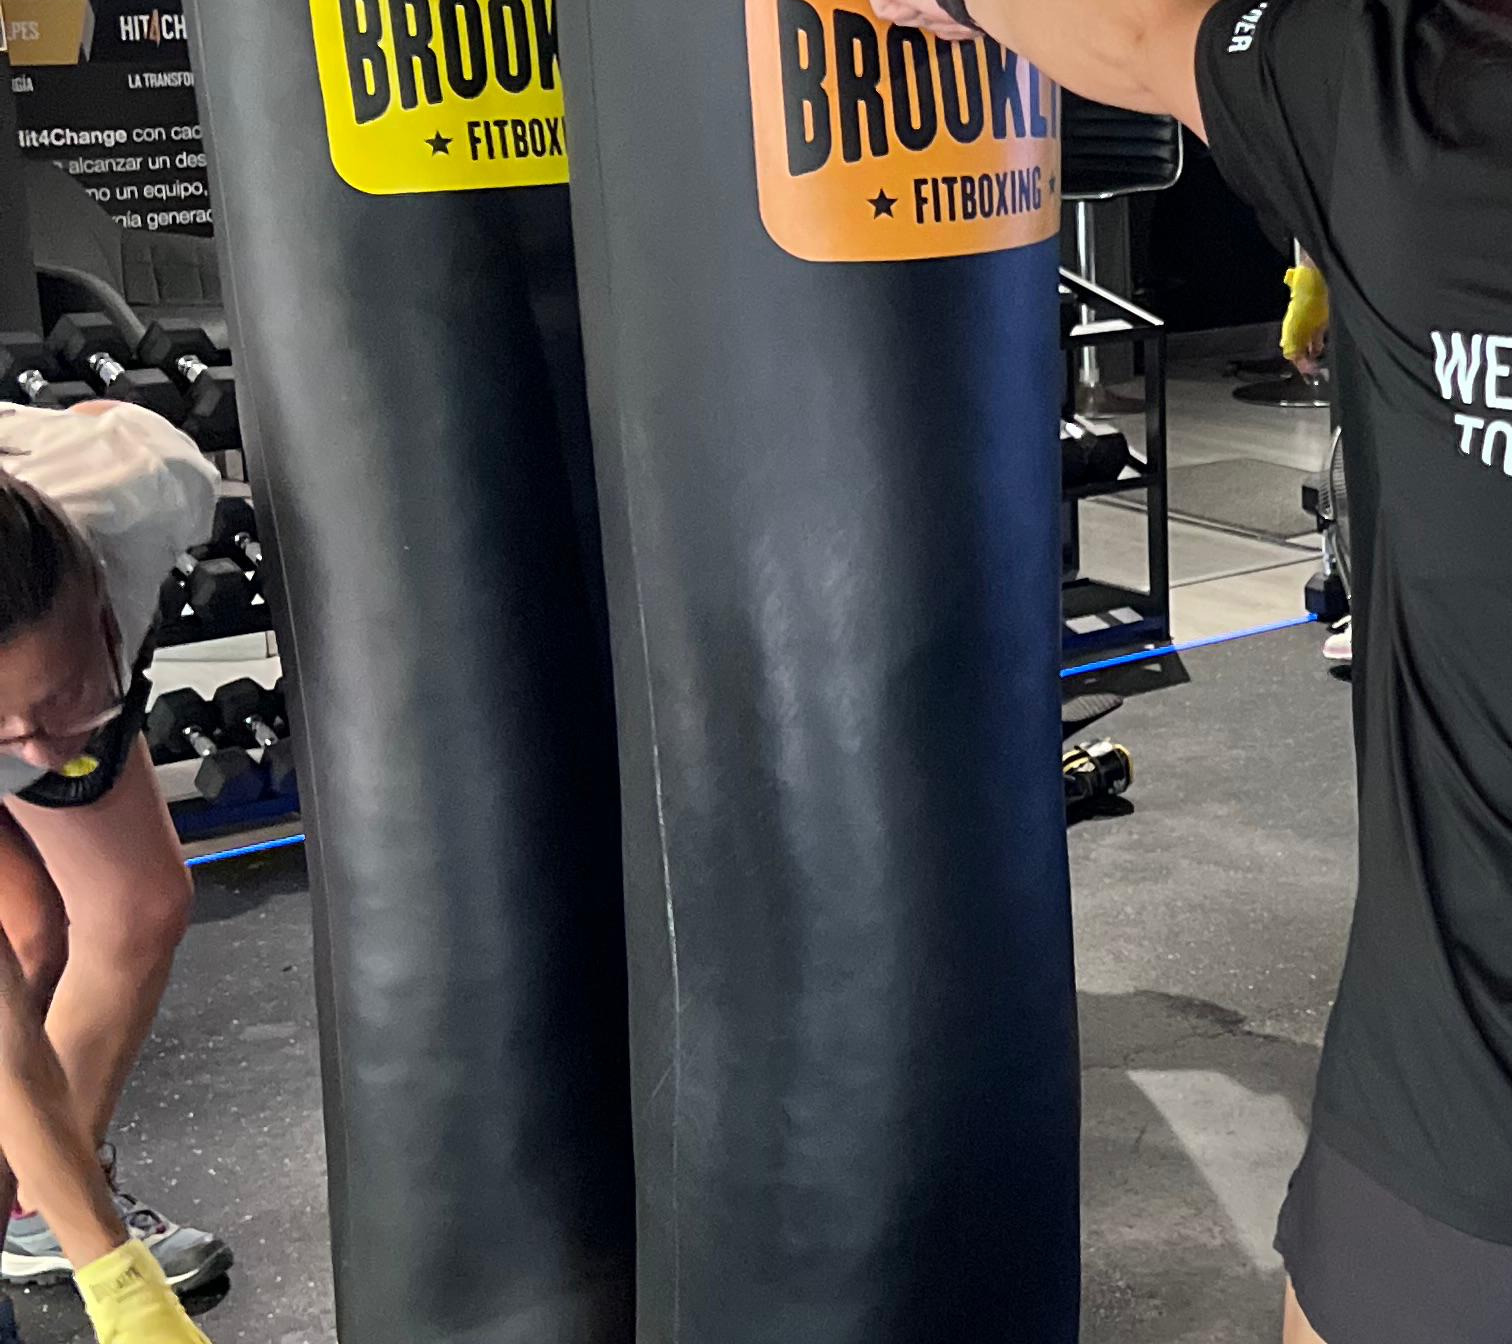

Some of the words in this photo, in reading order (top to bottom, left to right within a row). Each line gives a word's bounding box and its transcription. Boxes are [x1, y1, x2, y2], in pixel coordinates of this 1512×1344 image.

[128, 73, 142, 89] LA
[132, 127, 166, 143] con
[68, 156, 144, 175] alcanzar
[149, 155, 170, 170] un
[116, 185, 138, 200] un
[912, 165, 1042, 224] FITBOXING
